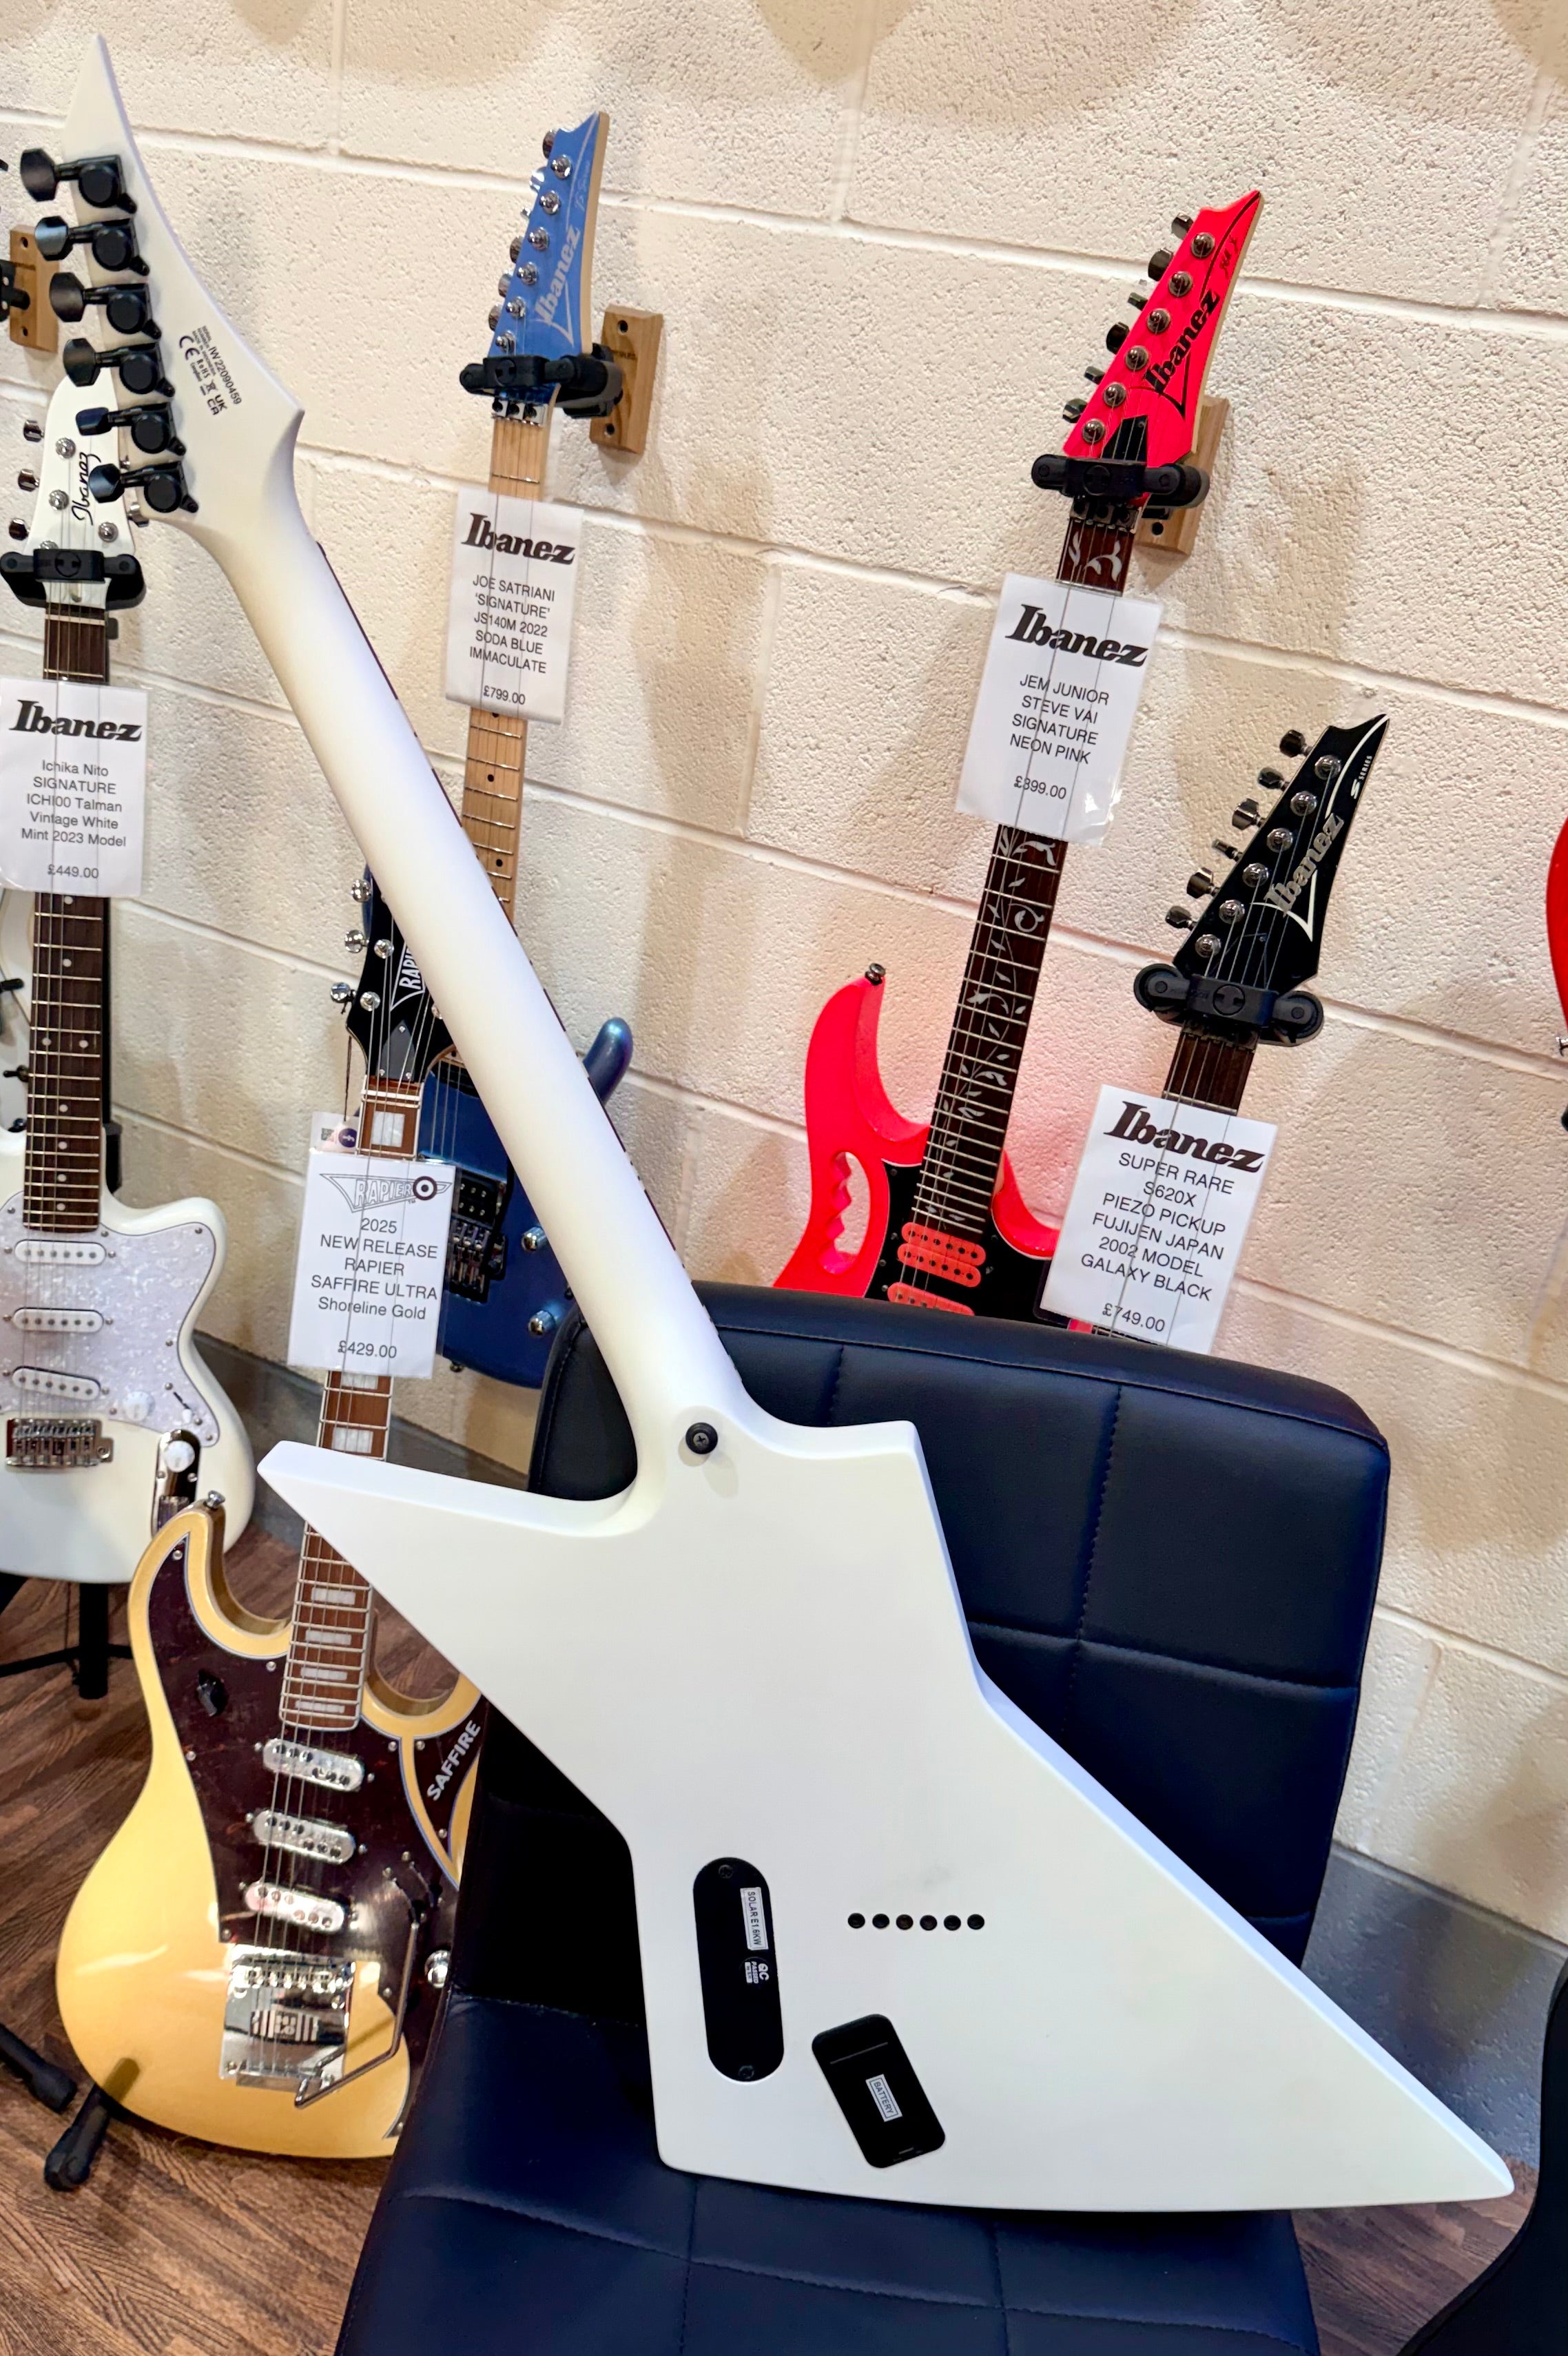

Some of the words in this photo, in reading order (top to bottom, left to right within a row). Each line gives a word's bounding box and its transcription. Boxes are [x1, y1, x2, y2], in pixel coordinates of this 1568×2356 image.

[535, 224, 581, 327] Ibanez
[1144, 288, 1220, 395] Ibanez
[461, 512, 575, 565] Ibanez
[473, 575, 495, 590] JOE
[499, 579, 555, 601] SATRIANI
[474, 612, 516, 631] JS140M
[519, 621, 548, 637] 2022
[1004, 603, 1148, 668] Ibanez
[475, 630, 507, 648] SODA
[511, 637, 544, 654] BLUE
[470, 646, 546, 673] IMMACULATE
[483, 685, 526, 705] £799.00
[1020, 674, 1050, 692] JEM
[1053, 682, 1109, 705] JUNIOR
[9, 699, 143, 742] Ibanez
[1022, 695, 1070, 717] STEVE
[1074, 707, 1097, 724] VAI
[1012, 714, 1099, 745] SIGNATURE
[1010, 734, 1052, 755] NEON
[1055, 744, 1091, 764] PINK
[42, 759, 79, 774] Ichika
[83, 763, 109, 776] Nito
[1358, 755, 1372, 780] SERIES
[33, 776, 116, 794] SIGNATURE
[75, 798, 122, 812] Talman
[30, 811, 78, 827] Vintage
[83, 816, 118, 829] White
[21, 827, 48, 840] Mint
[53, 830, 83, 843] 2023
[88, 834, 126, 847] Model
[48, 864, 99, 878] £449.00
[1264, 812, 1344, 918] Ibanez
[1103, 1100, 1266, 1173] Ibanez
[1119, 1153, 1179, 1180] SUPER
[1184, 1169, 1235, 1195] RARE
[354, 1179, 414, 1208] RAPIER
[1143, 1181, 1197, 1208] S620X
[360, 1218, 397, 1234] 2025
[1102, 1192, 1155, 1218] PIEZO
[1159, 1208, 1226, 1236] PICKUP
[320, 1234, 360, 1250] NEW
[363, 1239, 438, 1259] RELEASE
[1093, 1212, 1162, 1243] FUJIJEN
[1166, 1234, 1224, 1259] JAPAN
[344, 1258, 404, 1276] RAPIER
[1099, 1237, 1138, 1258] 2002
[1142, 1248, 1204, 1277] MODEL
[311, 1275, 380, 1294] SAFFIRE
[384, 1283, 437, 1300] ULTRA
[1081, 1254, 1151, 1284] GALAXY
[1153, 1274, 1213, 1301] BLACK
[318, 1296, 386, 1316] Shoreline
[392, 1304, 426, 1320] Gold
[1102, 1303, 1165, 1332] £749.00
[338, 1340, 398, 1358] £429.00
[426, 1719, 481, 1801] SAFFIRE
[747, 1891, 759, 1917] SOLAR
[874, 2081, 894, 2113] BATTERY
